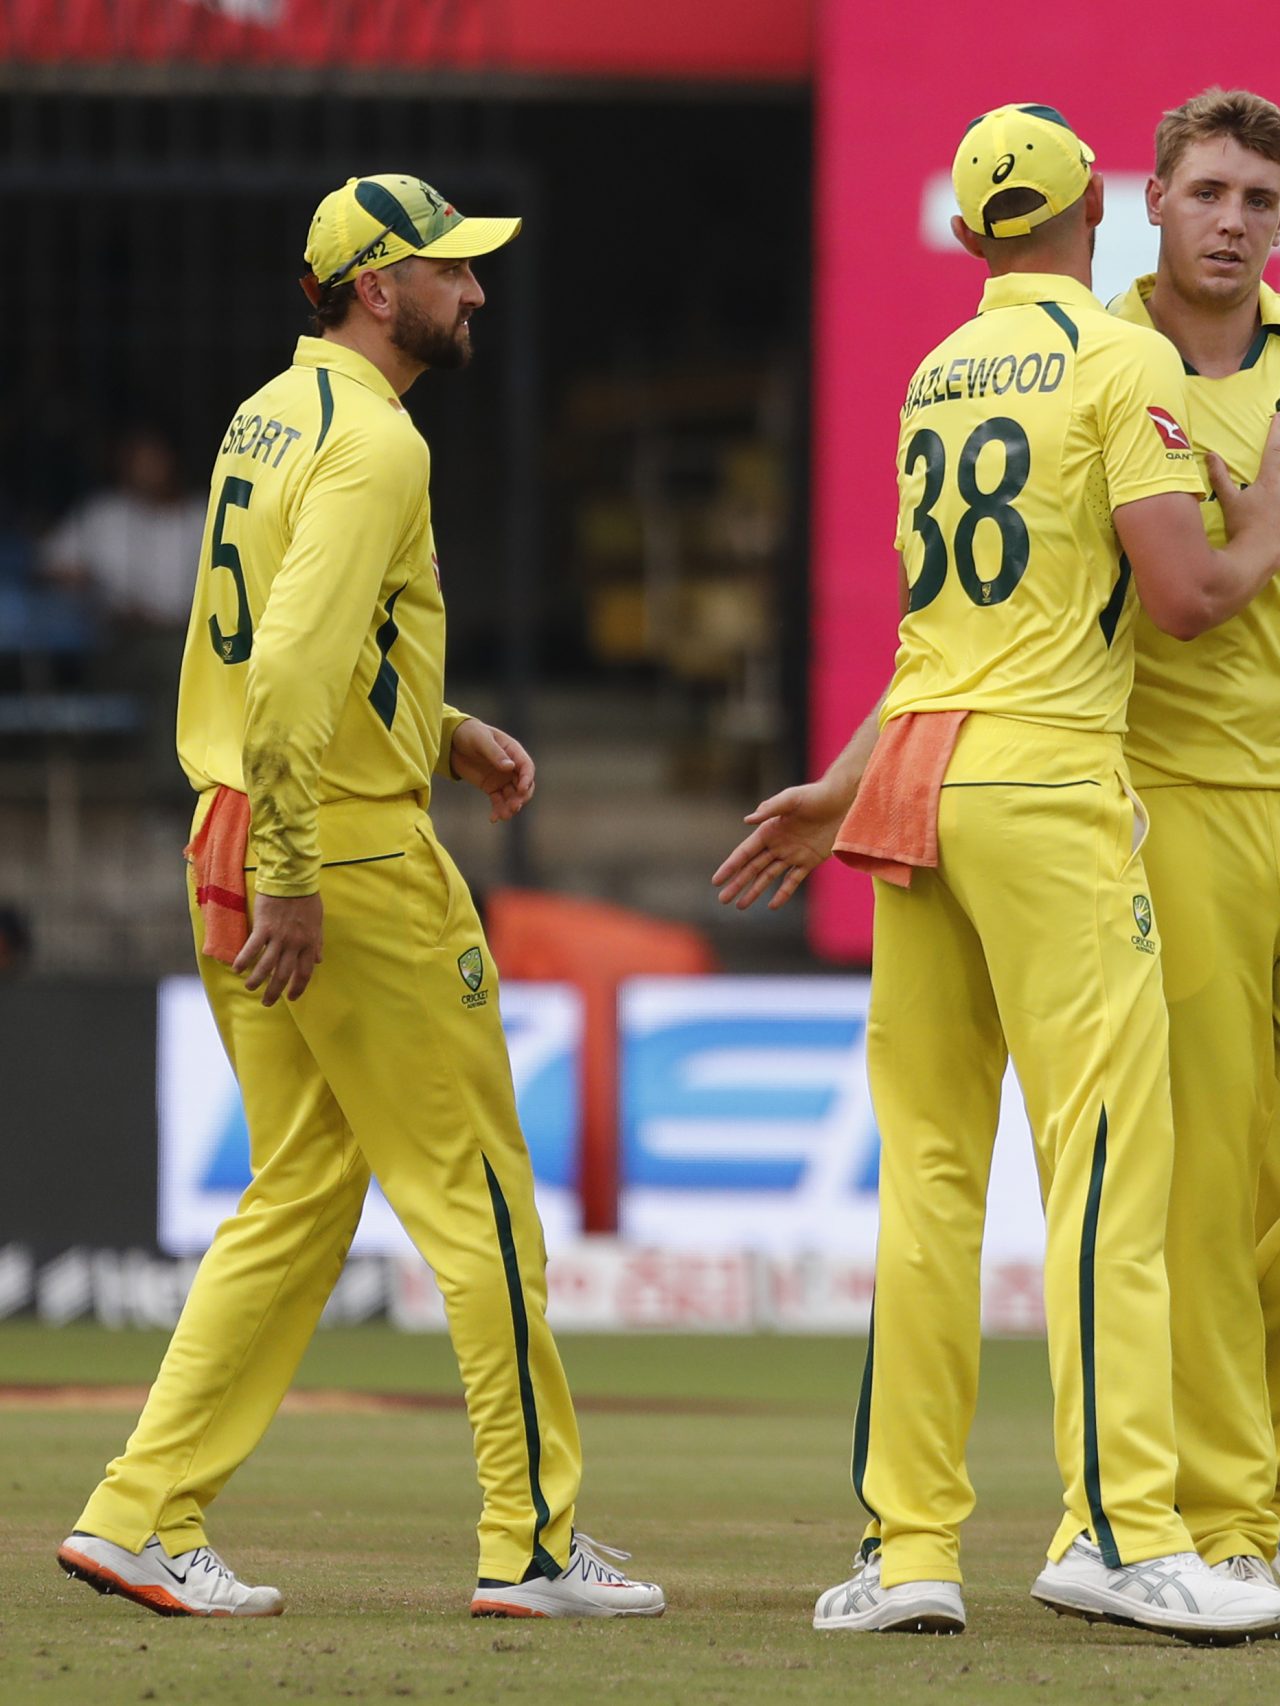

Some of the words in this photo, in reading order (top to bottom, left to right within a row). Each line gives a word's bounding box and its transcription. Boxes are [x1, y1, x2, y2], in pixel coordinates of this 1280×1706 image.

[222, 414, 302, 469] SHORT
[208, 475, 254, 665] 5
[904, 416, 1031, 614] 38
[461, 989, 488, 1005] CRICKET
